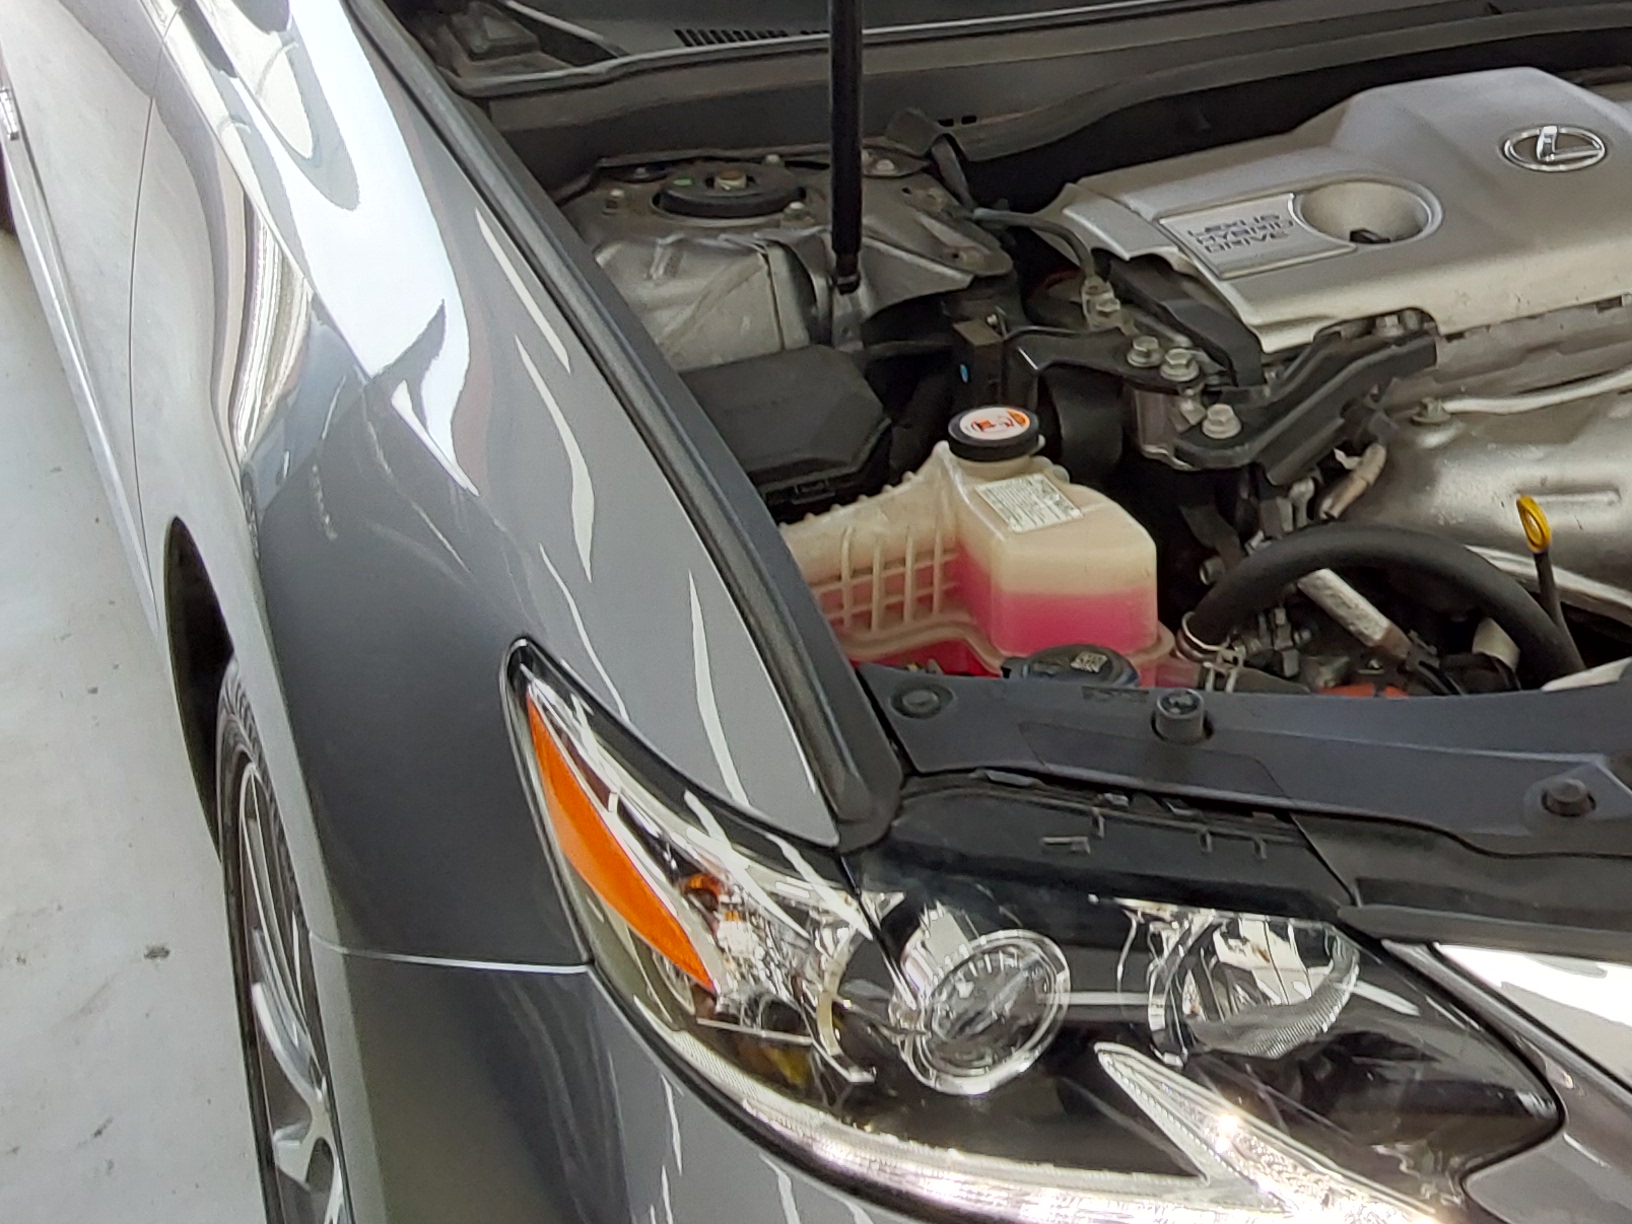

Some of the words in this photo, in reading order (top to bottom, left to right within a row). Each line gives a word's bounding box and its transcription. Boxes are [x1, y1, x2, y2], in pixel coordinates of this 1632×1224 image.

[1186, 214, 1281, 237] LEXUS
[1196, 220, 1294, 246] HYBRID
[1204, 231, 1290, 254] DRIVE
